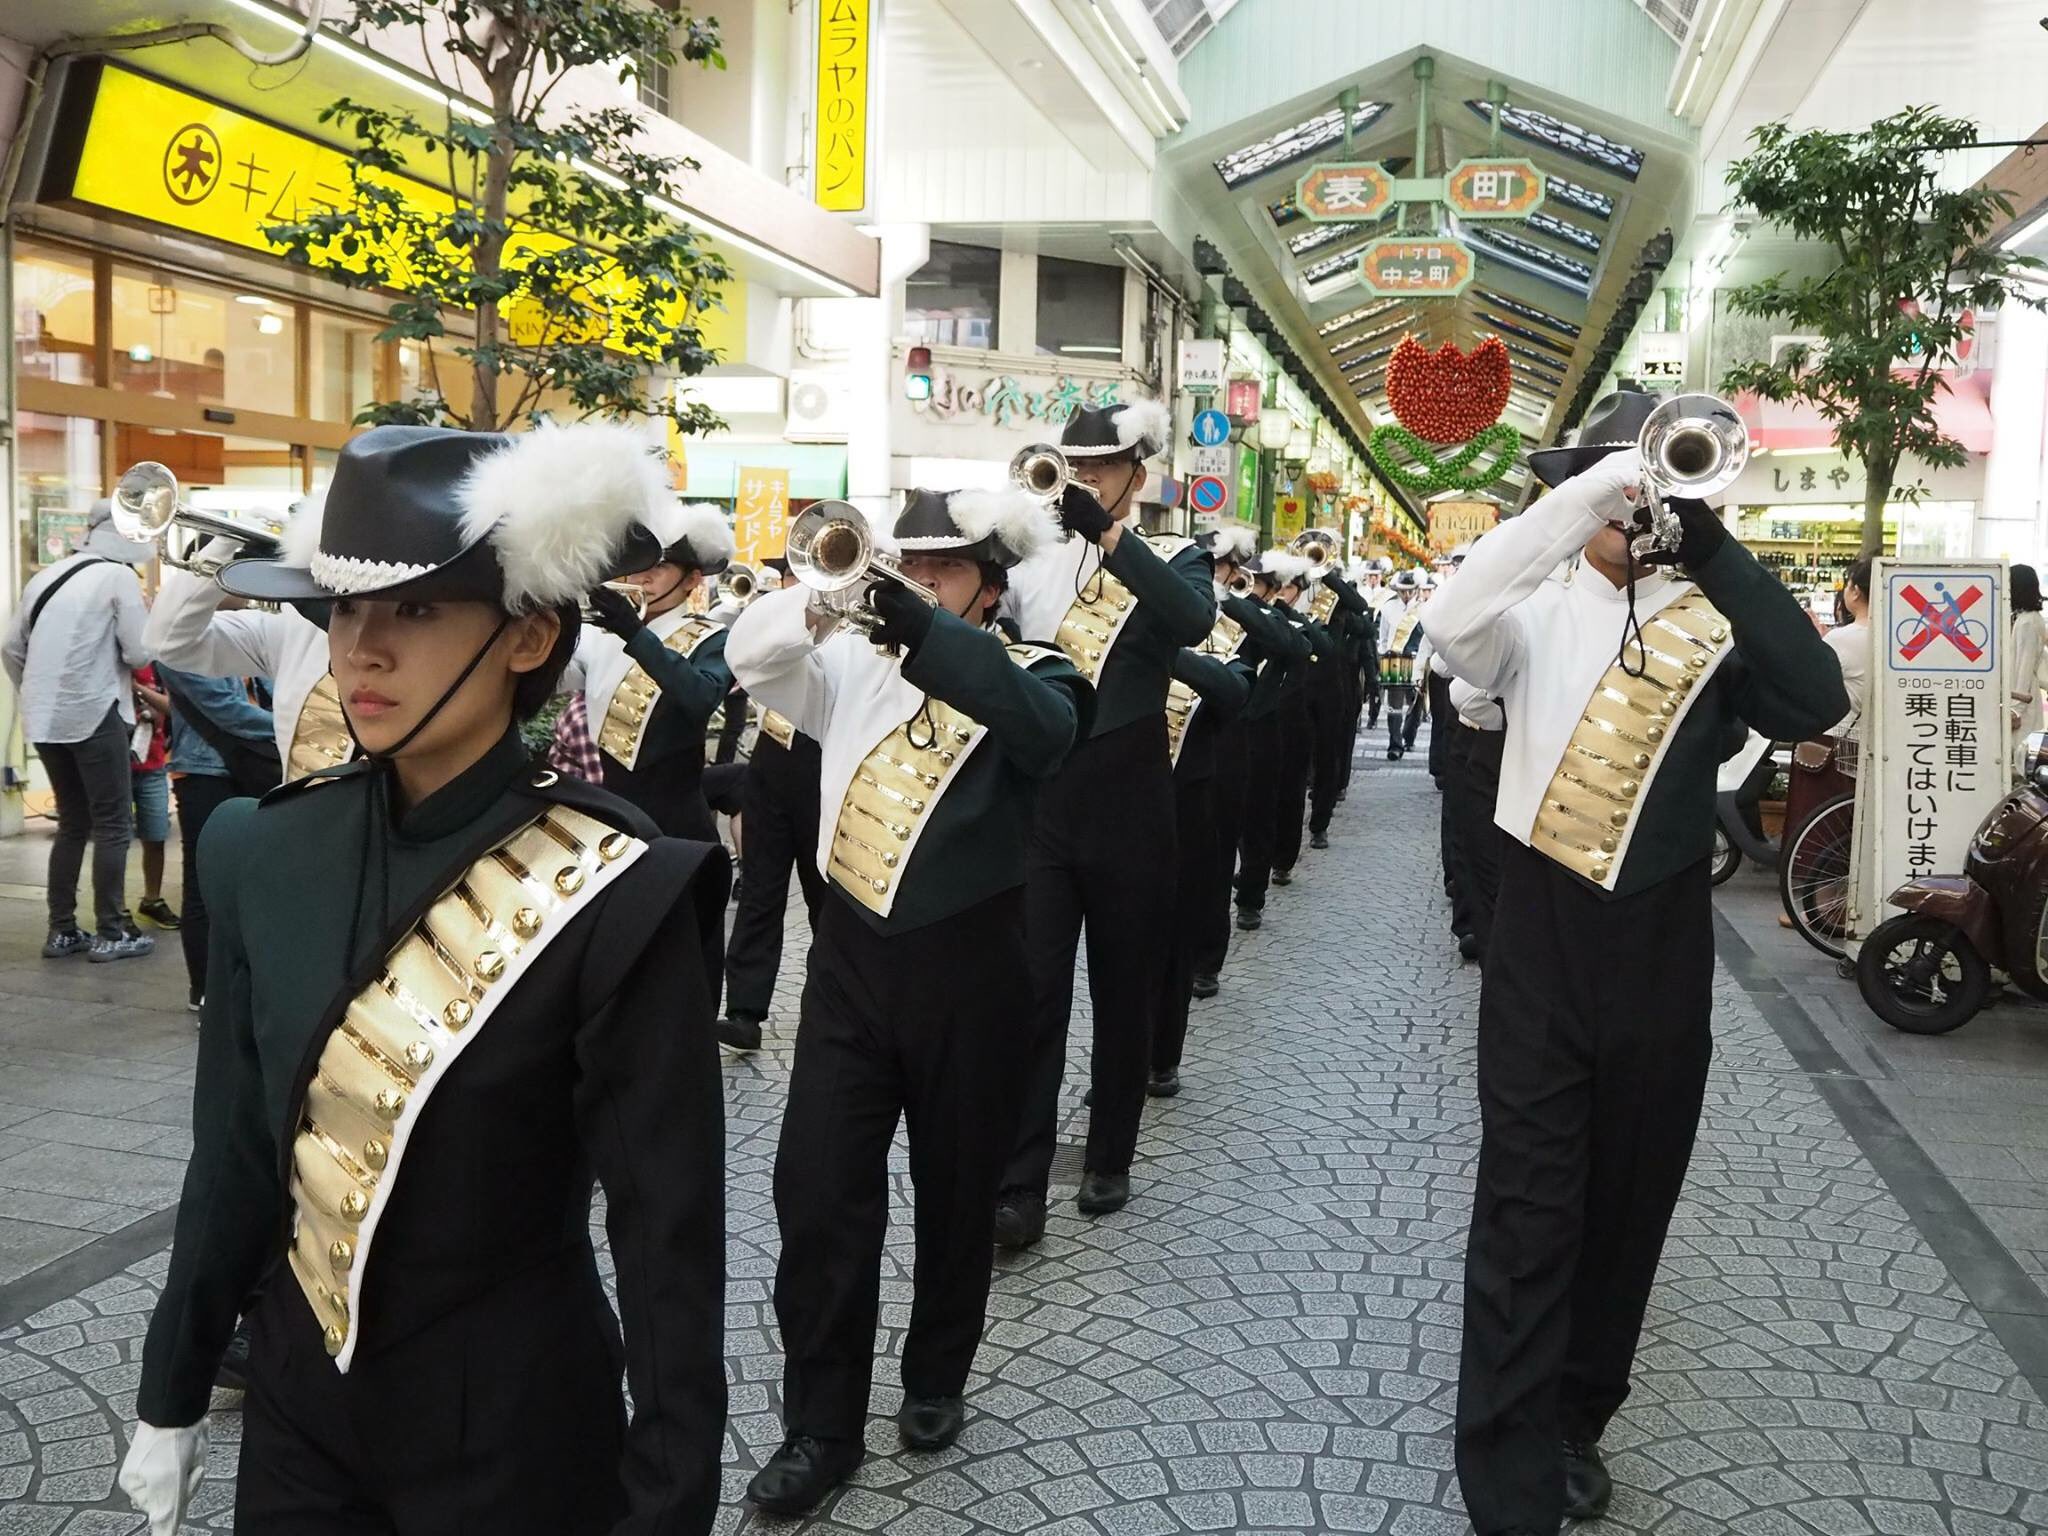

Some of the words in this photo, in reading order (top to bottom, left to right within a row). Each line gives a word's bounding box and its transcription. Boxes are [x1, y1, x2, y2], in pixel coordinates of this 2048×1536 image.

[826, 0, 857, 192] ムラヤのパン
[1324, 175, 1367, 210] 表
[1473, 170, 1517, 206] 町
[1382, 266, 1450, 286] 中之町
[1773, 466, 1850, 492] しまや
[768, 480, 784, 539] キムラヤ
[1945, 693, 1978, 792] 自転車に
